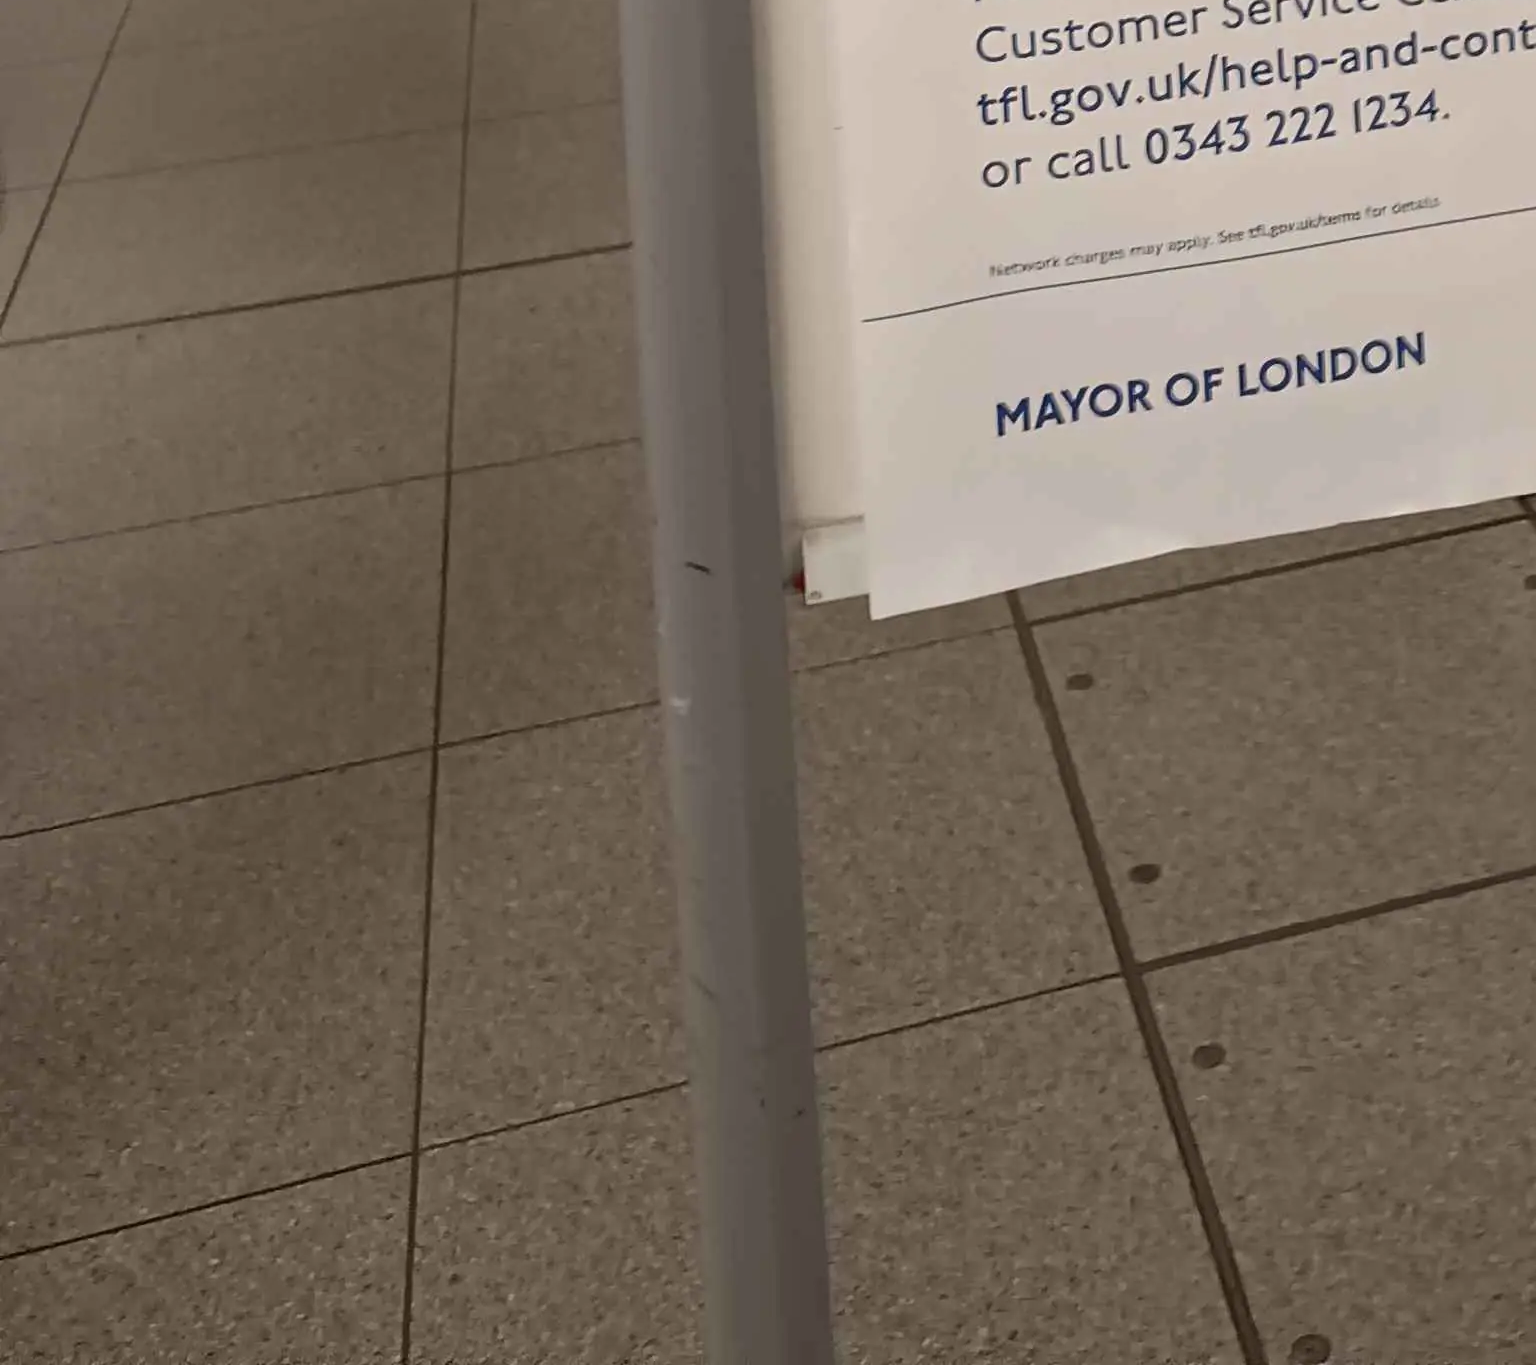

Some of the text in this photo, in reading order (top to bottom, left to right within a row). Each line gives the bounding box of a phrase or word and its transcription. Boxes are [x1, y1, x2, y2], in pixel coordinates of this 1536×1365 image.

[976, 6, 1208, 62] Customer
[981, 88, 1450, 188] or call 0343 222 1234.
[996, 332, 1425, 437] MAYOR OF LONDON
